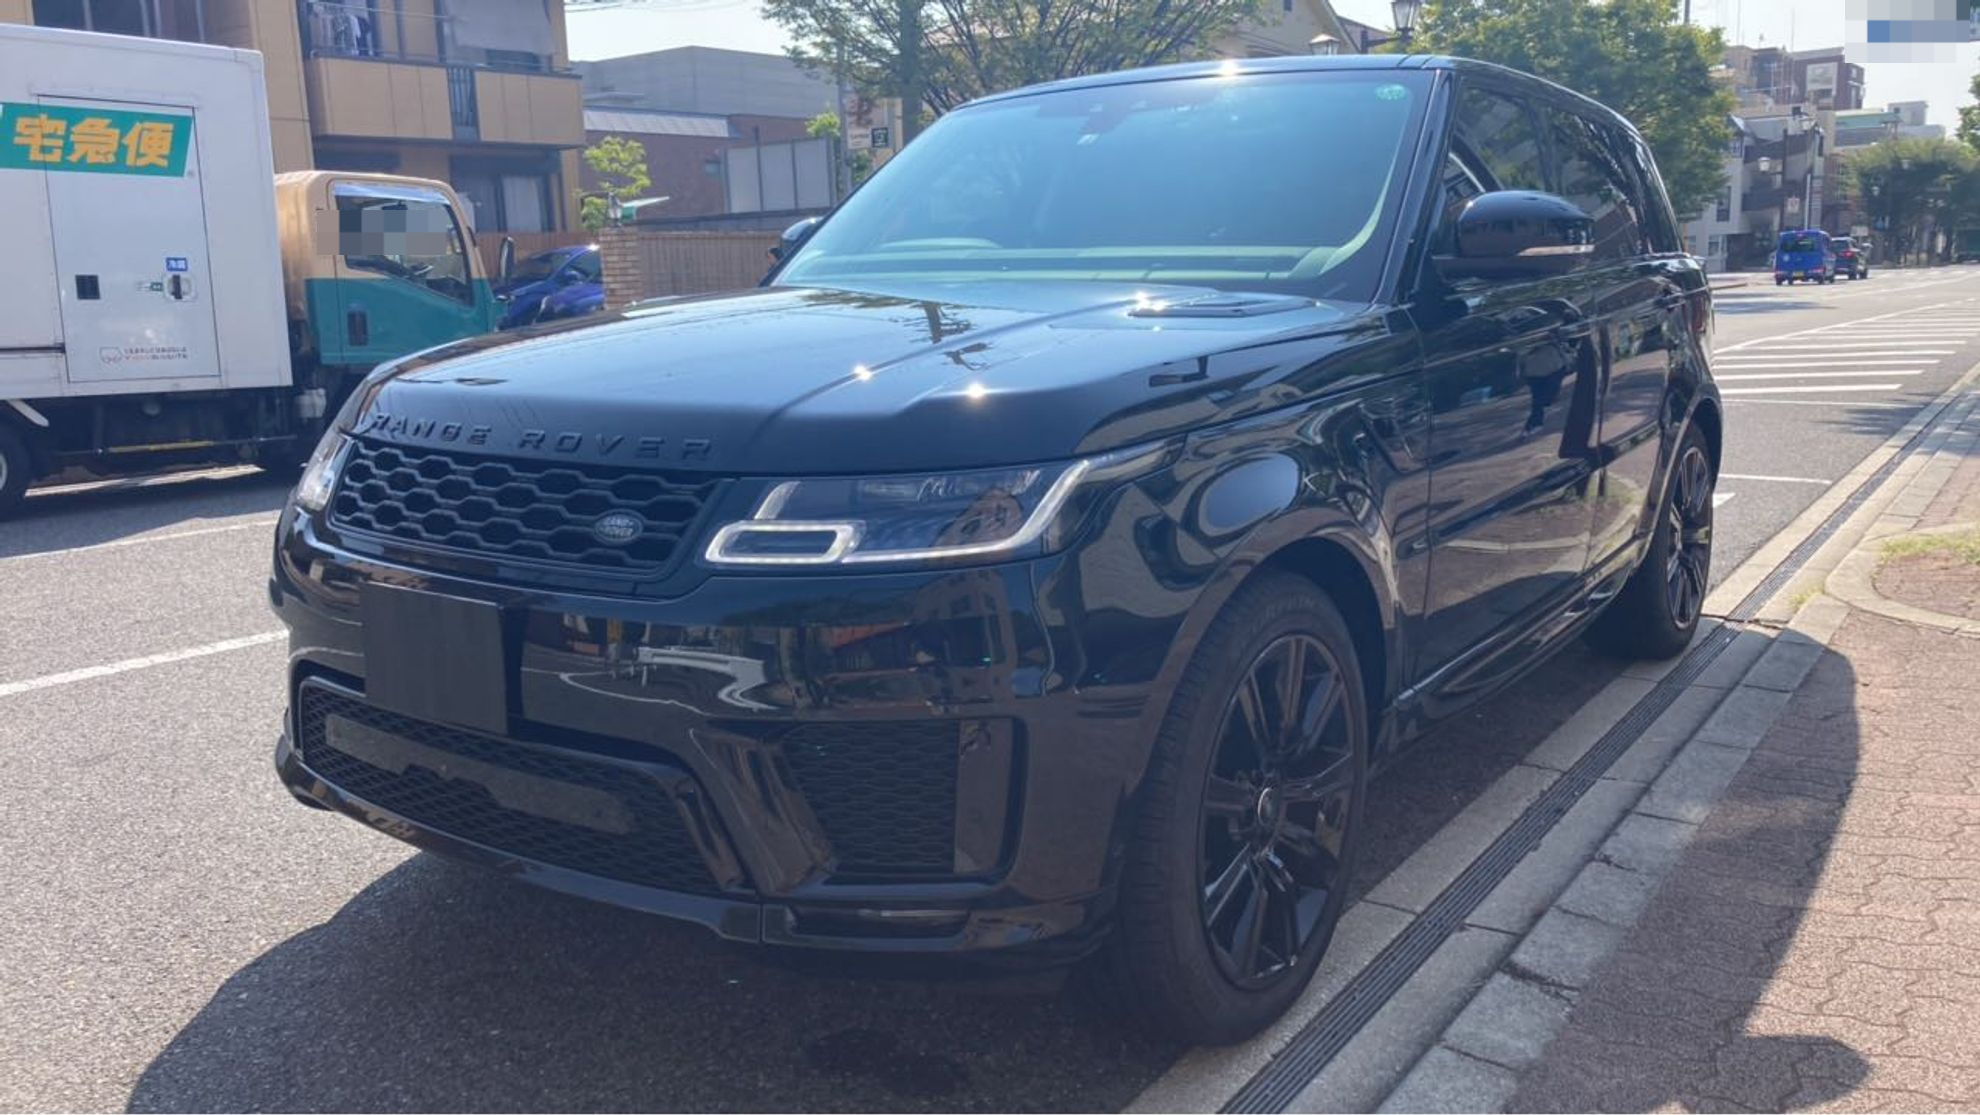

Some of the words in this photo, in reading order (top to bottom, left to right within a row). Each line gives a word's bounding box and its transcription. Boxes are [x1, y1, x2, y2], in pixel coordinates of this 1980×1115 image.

[12, 113, 174, 168] 宅急便
[371, 412, 492, 446] RANGE
[518, 429, 713, 460] ROVER
